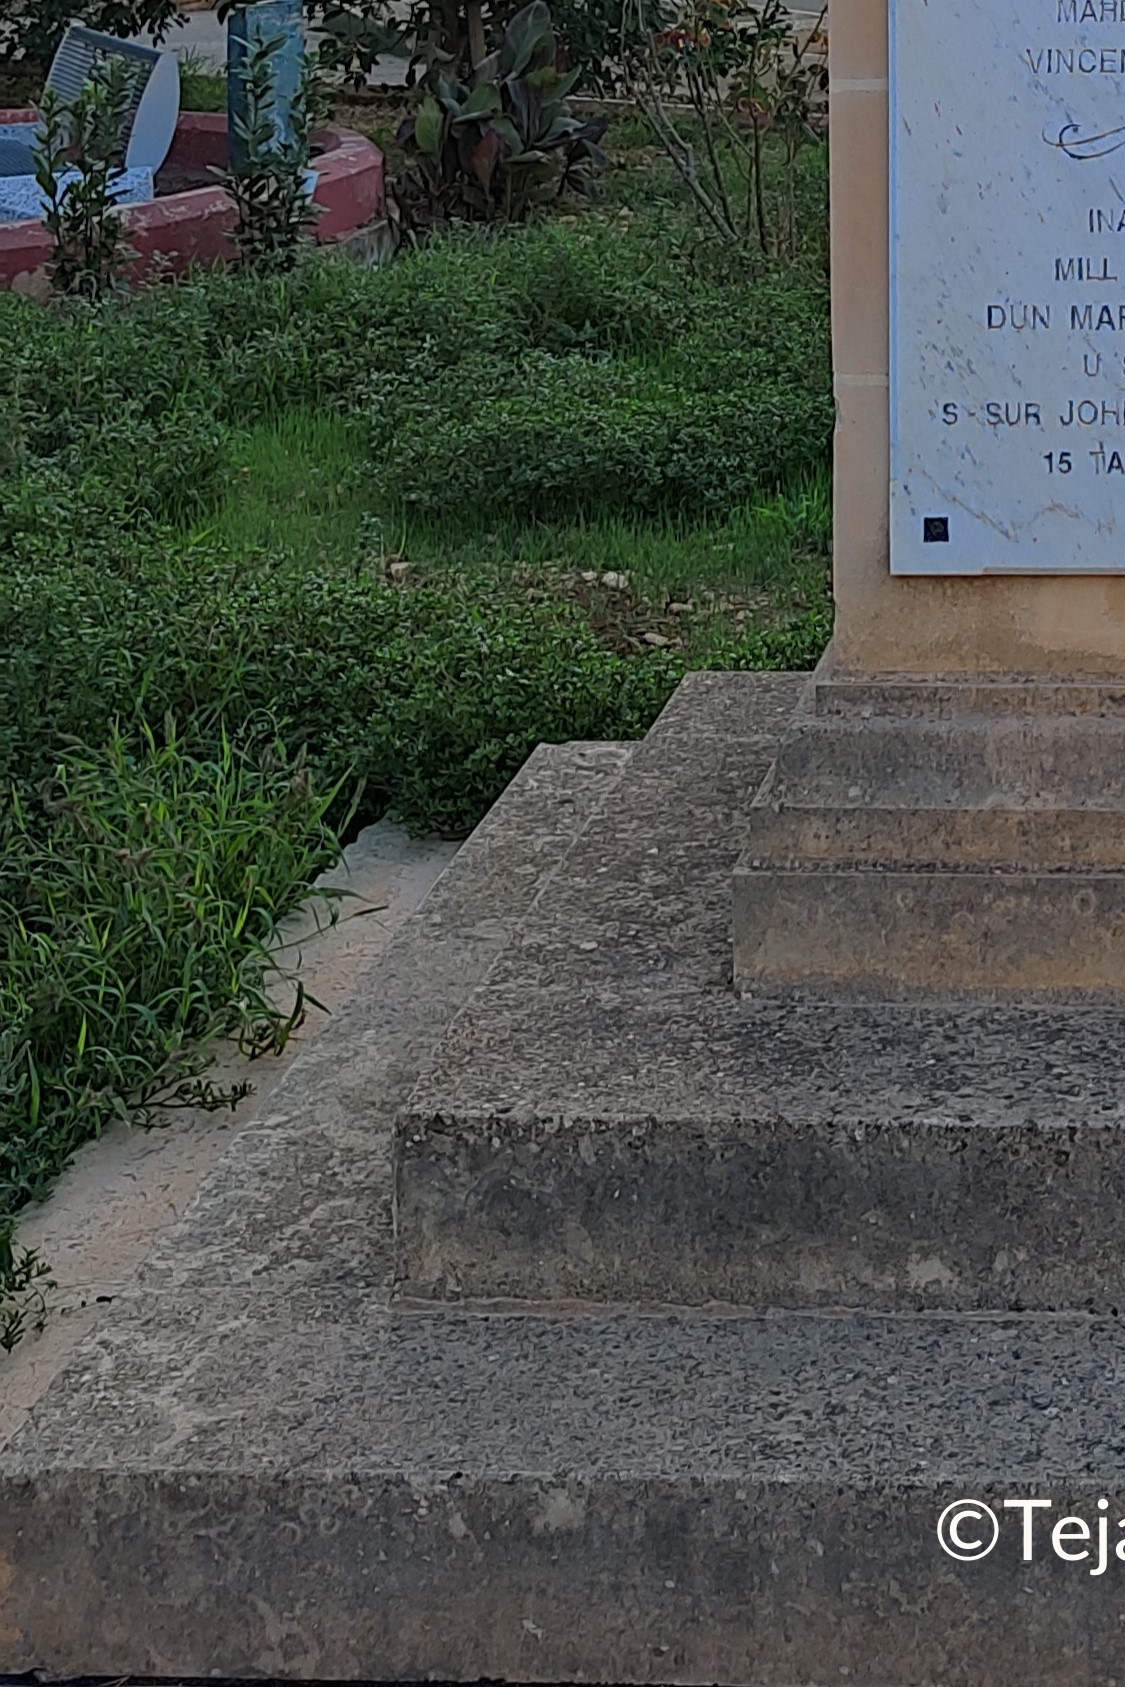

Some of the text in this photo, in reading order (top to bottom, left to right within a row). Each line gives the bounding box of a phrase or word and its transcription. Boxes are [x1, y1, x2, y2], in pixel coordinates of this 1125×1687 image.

[987, 306, 1050, 331] DUN
[1083, 354, 1101, 376] U
[1043, 452, 1072, 475] 15
